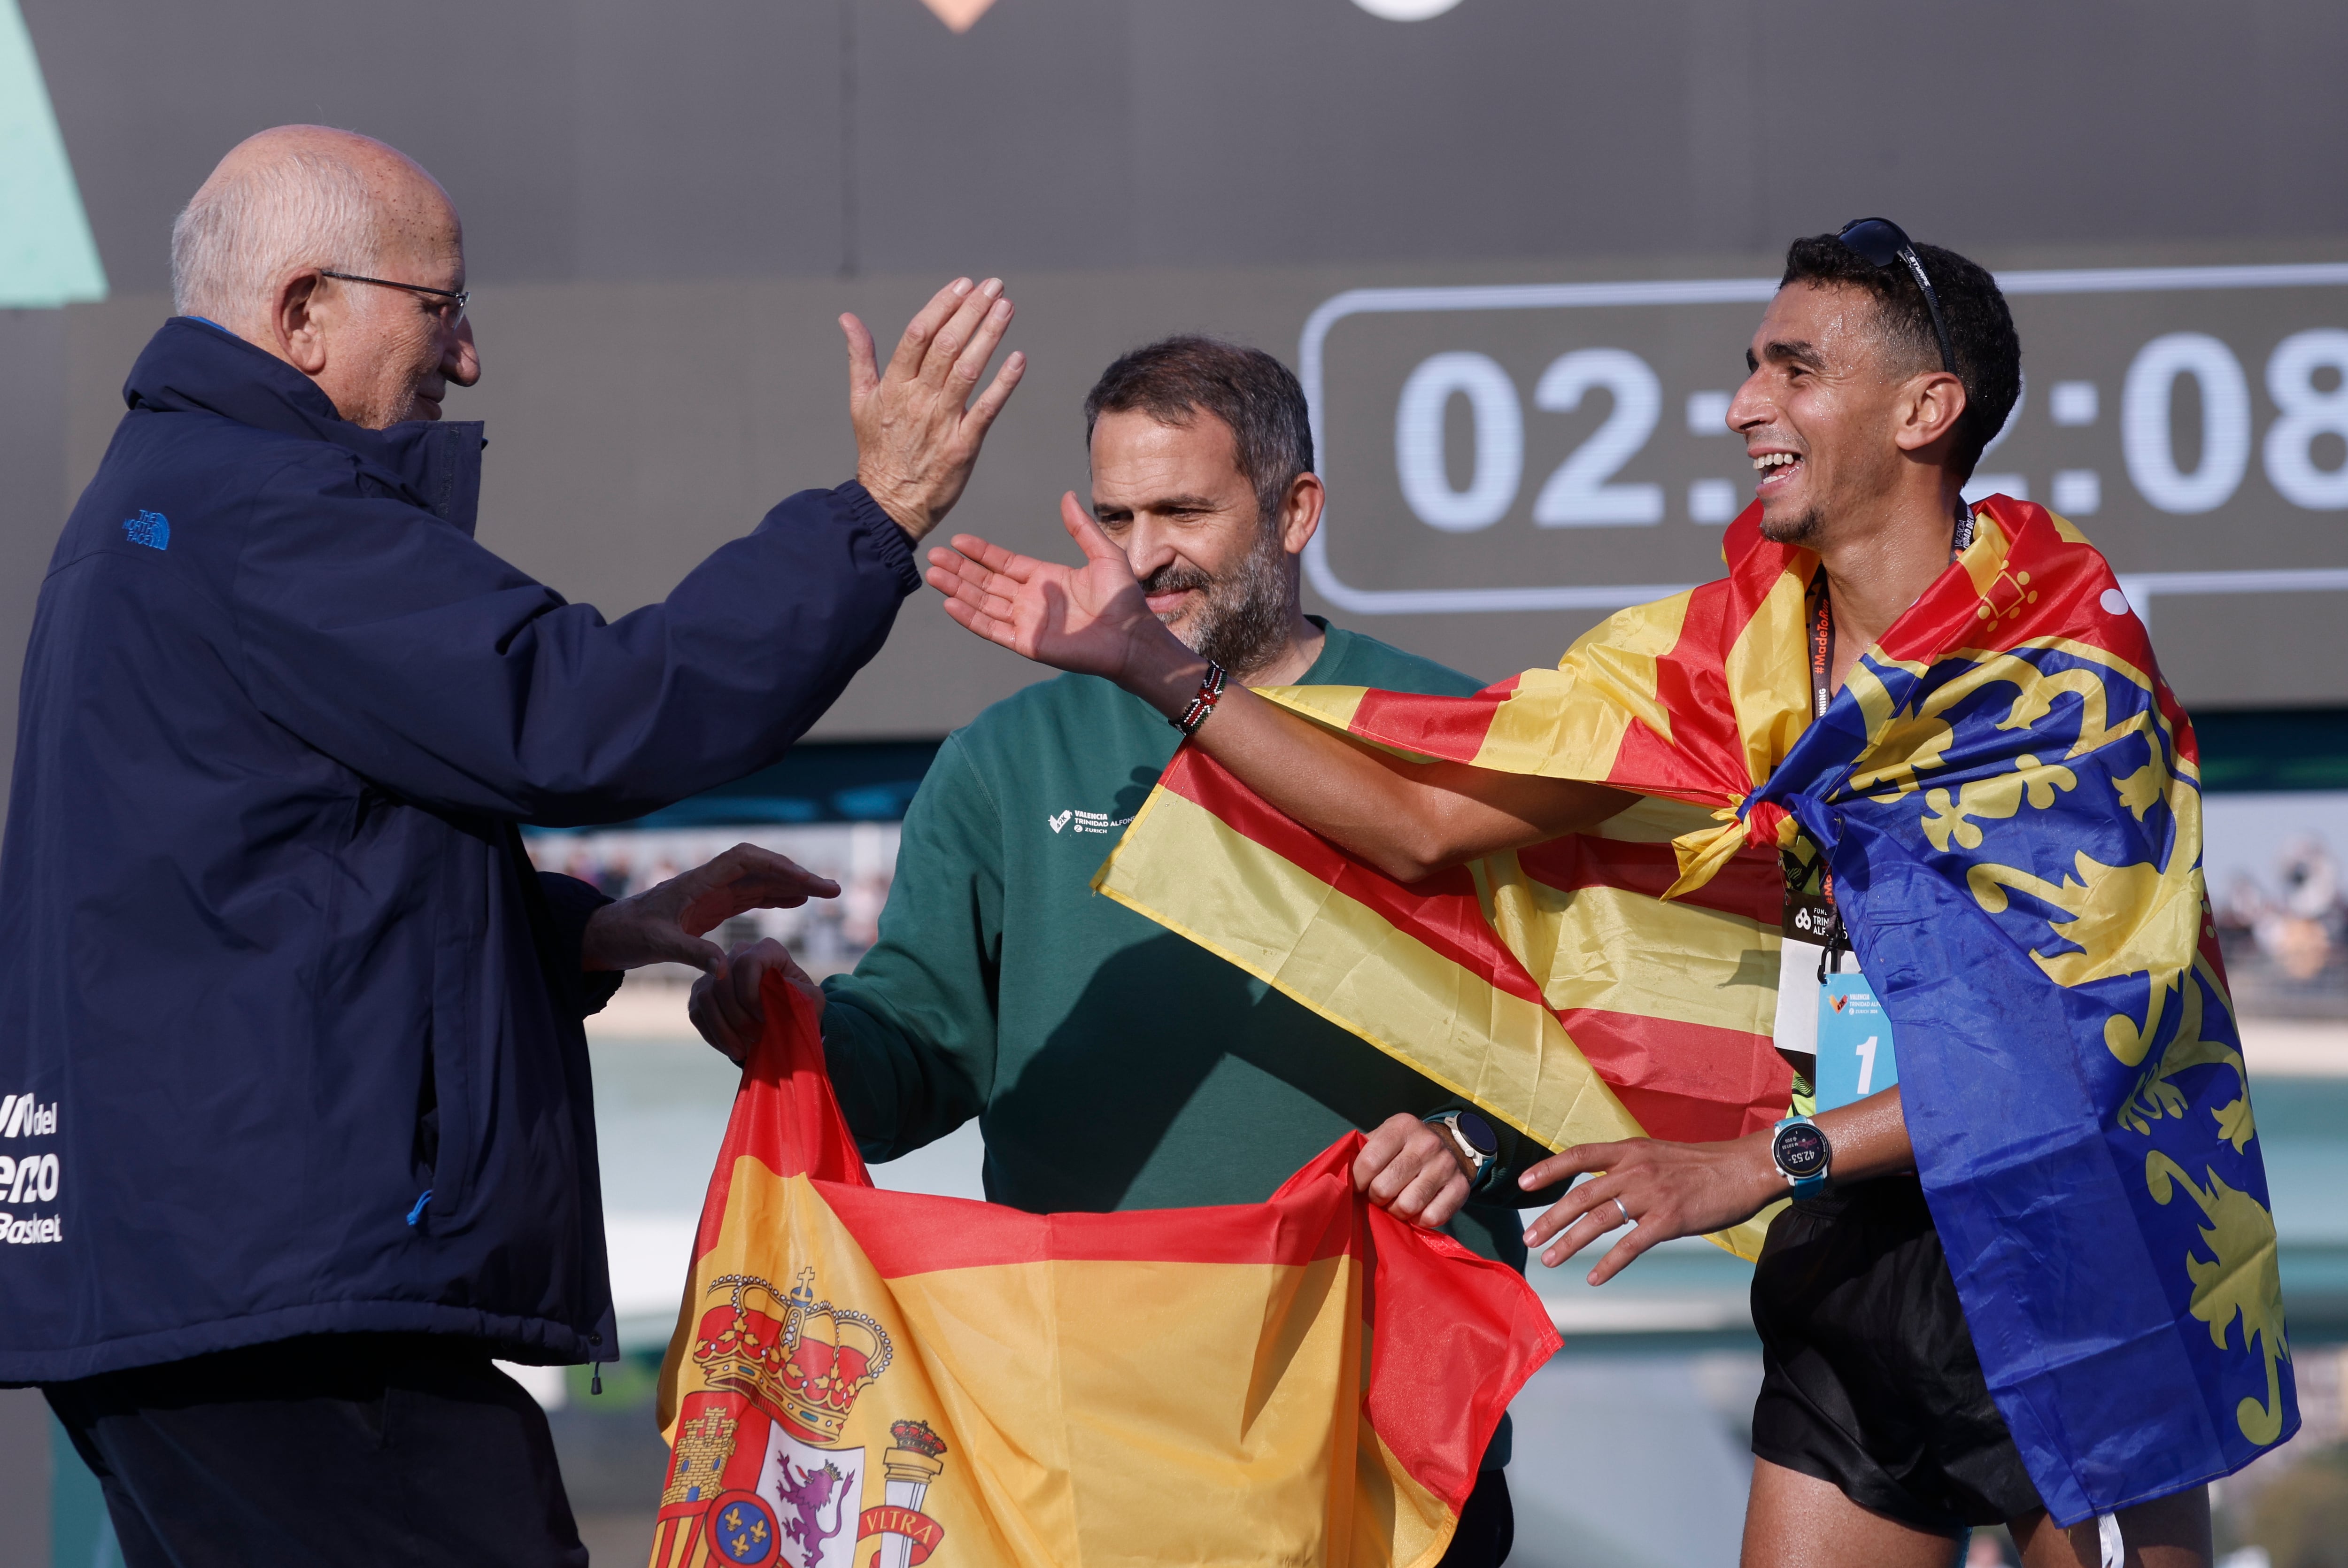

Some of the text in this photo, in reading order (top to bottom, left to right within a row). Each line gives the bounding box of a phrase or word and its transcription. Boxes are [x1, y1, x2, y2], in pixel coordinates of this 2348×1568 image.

[139, 510, 156, 522] THE
[122, 518, 154, 534] NORTH
[1954, 519, 1966, 547] VALENCIA
[127, 531, 152, 545] FACE
[1815, 599, 1829, 674] #MadeToRun
[1057, 816, 1066, 828] 42K
[1074, 810, 1108, 820] VALENCIA
[1074, 818, 1109, 827] TRINIDAD
[1856, 1036, 1878, 1094] 1
[33, 1102, 58, 1135] del
[1791, 1150, 1815, 1164] 42.53
[866, 1510, 933, 1545] VLTRA
